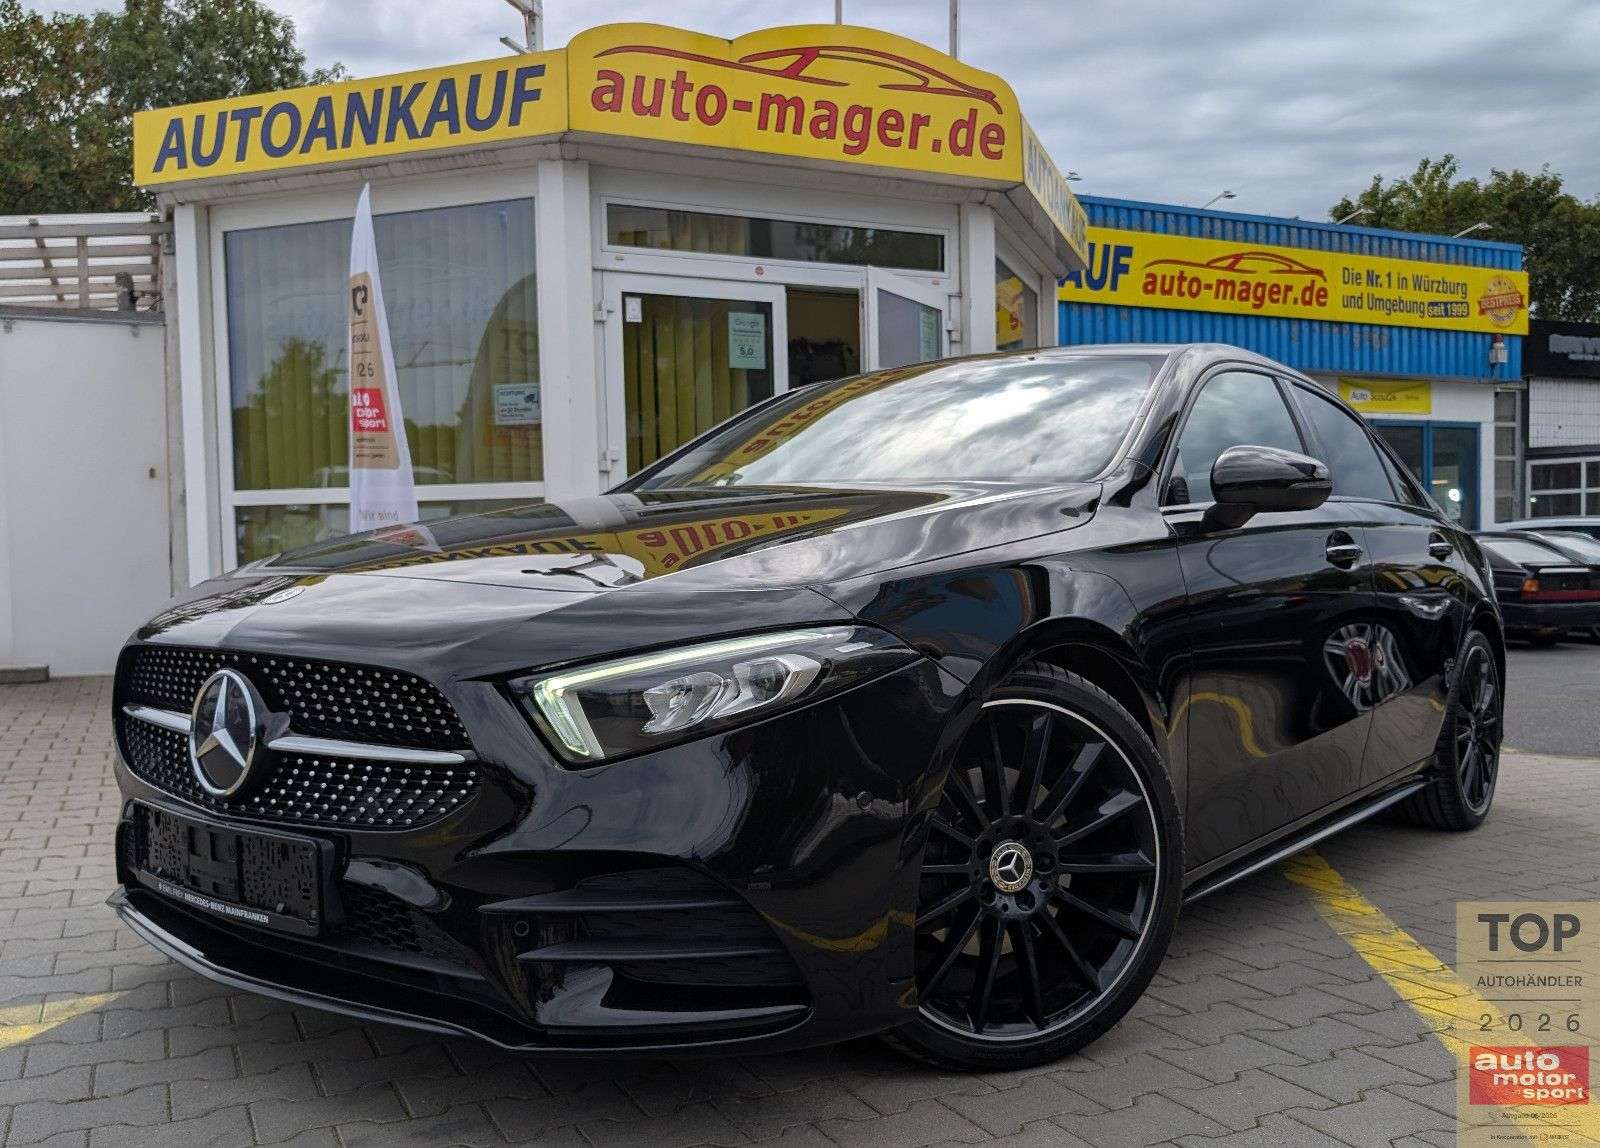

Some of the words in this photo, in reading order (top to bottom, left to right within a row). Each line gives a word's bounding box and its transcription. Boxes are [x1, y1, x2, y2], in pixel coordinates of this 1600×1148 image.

[152, 63, 546, 173] AUTOANKAUF
[590, 67, 1006, 160] auto-mager.de
[1141, 269, 1328, 309] auto-mager.de
[1342, 267, 1362, 285] Die
[1366, 269, 1383, 288] Nr.
[1386, 272, 1393, 289] 1
[1397, 273, 1408, 290] in
[1412, 274, 1468, 299] Würzburg
[1342, 292, 1363, 309] und
[1367, 293, 1425, 317] Umgebung
[1427, 303, 1445, 317] seit
[1447, 303, 1469, 317] 1999
[184, 892, 225, 912] MERCEDES-BENZ
[225, 905, 269, 923] MAINFRANKEN
